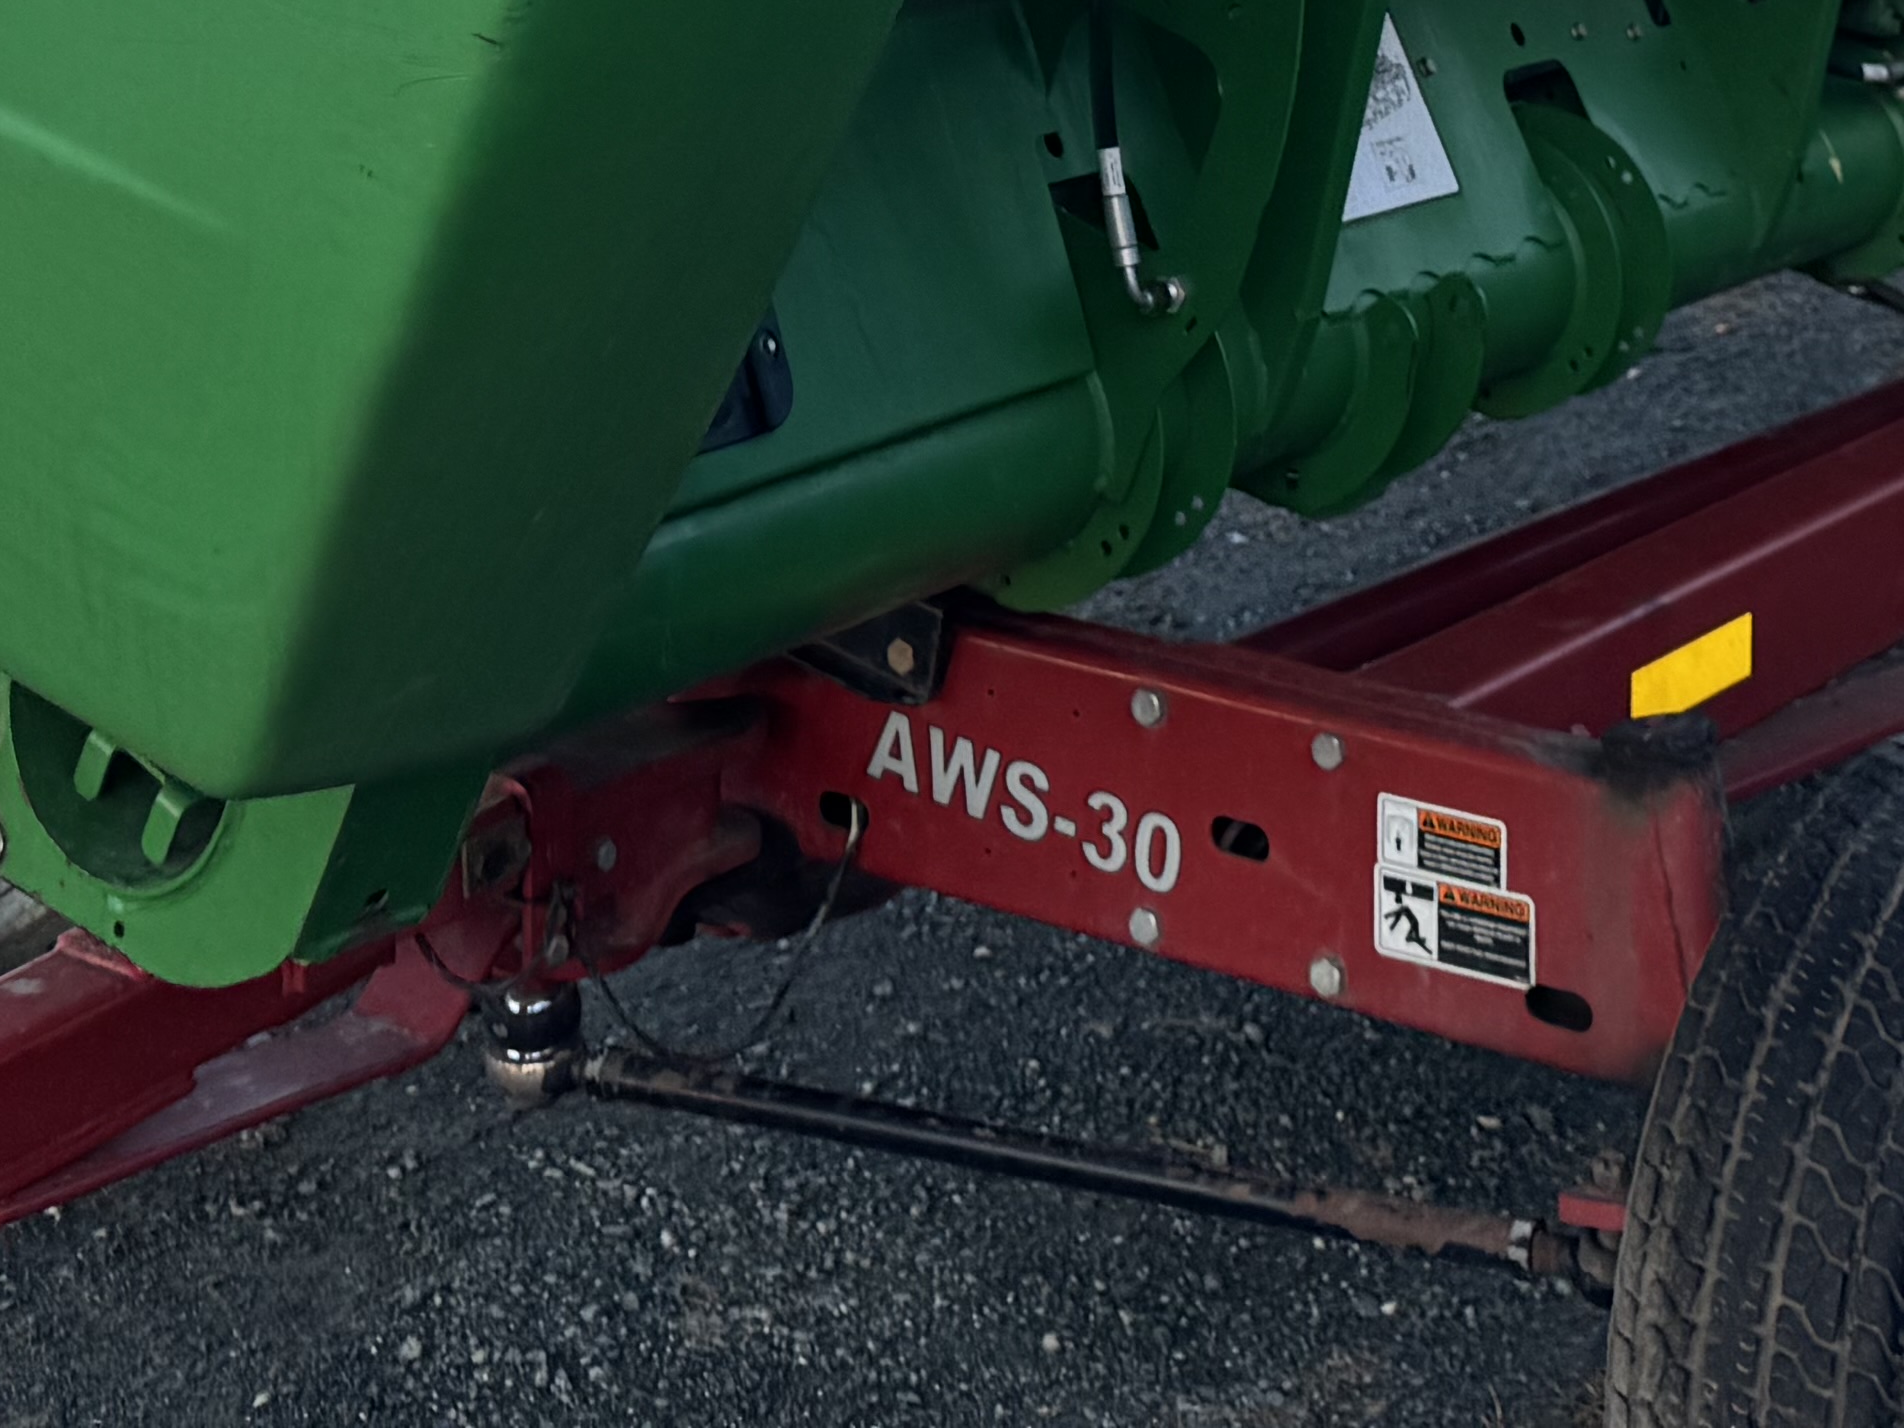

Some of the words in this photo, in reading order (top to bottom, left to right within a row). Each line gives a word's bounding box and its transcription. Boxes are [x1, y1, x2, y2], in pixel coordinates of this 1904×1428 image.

[866, 710, 1182, 894] AWS-30
[1436, 817, 1499, 844] WARNING
[1459, 890, 1525, 918] WARNING
